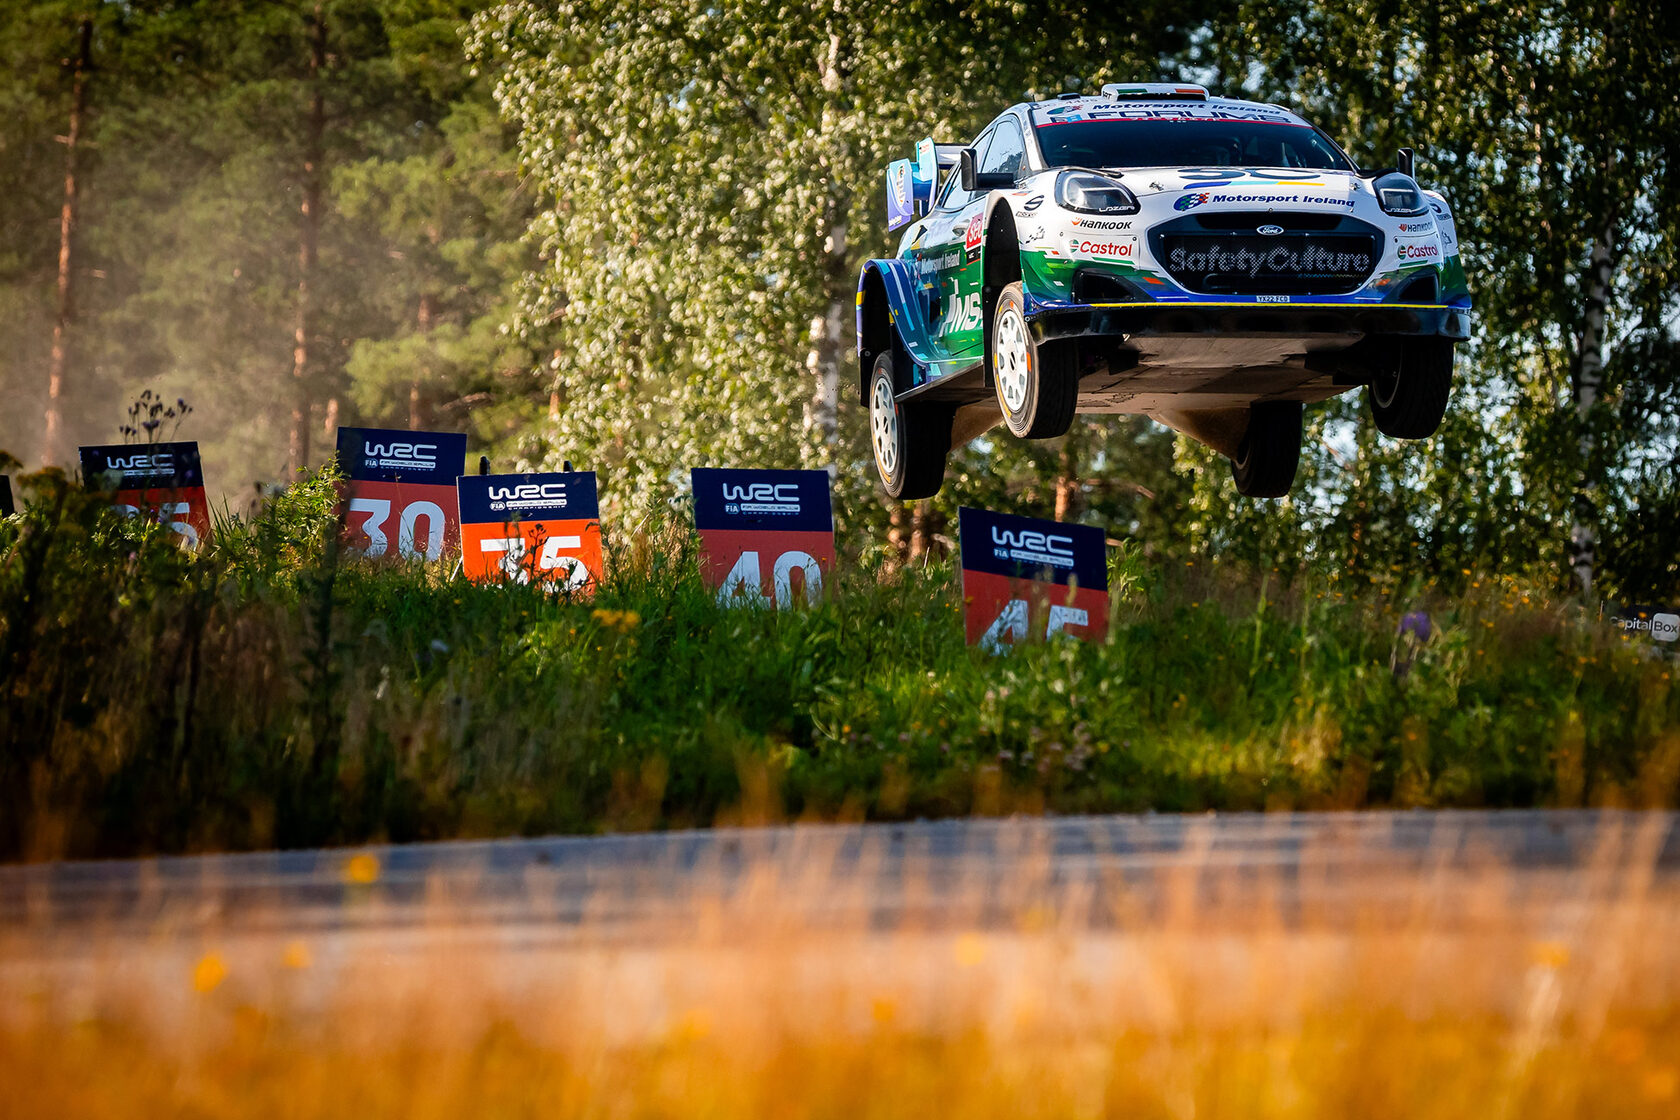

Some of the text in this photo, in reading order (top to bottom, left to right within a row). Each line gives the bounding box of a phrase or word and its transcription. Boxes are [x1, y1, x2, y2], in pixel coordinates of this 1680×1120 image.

[1211, 104, 1281, 115] Ireland
[1212, 194, 1356, 208] Motorsport Ireland
[1079, 240, 1133, 257] Castrol
[1406, 244, 1439, 258] Castrol
[1169, 244, 1370, 279] SafetyCulture
[364, 440, 438, 460] WRC
[106, 453, 174, 469] WRC
[488, 483, 567, 500] WRC
[722, 482, 800, 502] WRC
[349, 498, 446, 562] 30
[991, 525, 1074, 556] WRC
[480, 535, 590, 592] 35
[714, 550, 823, 613] 40
